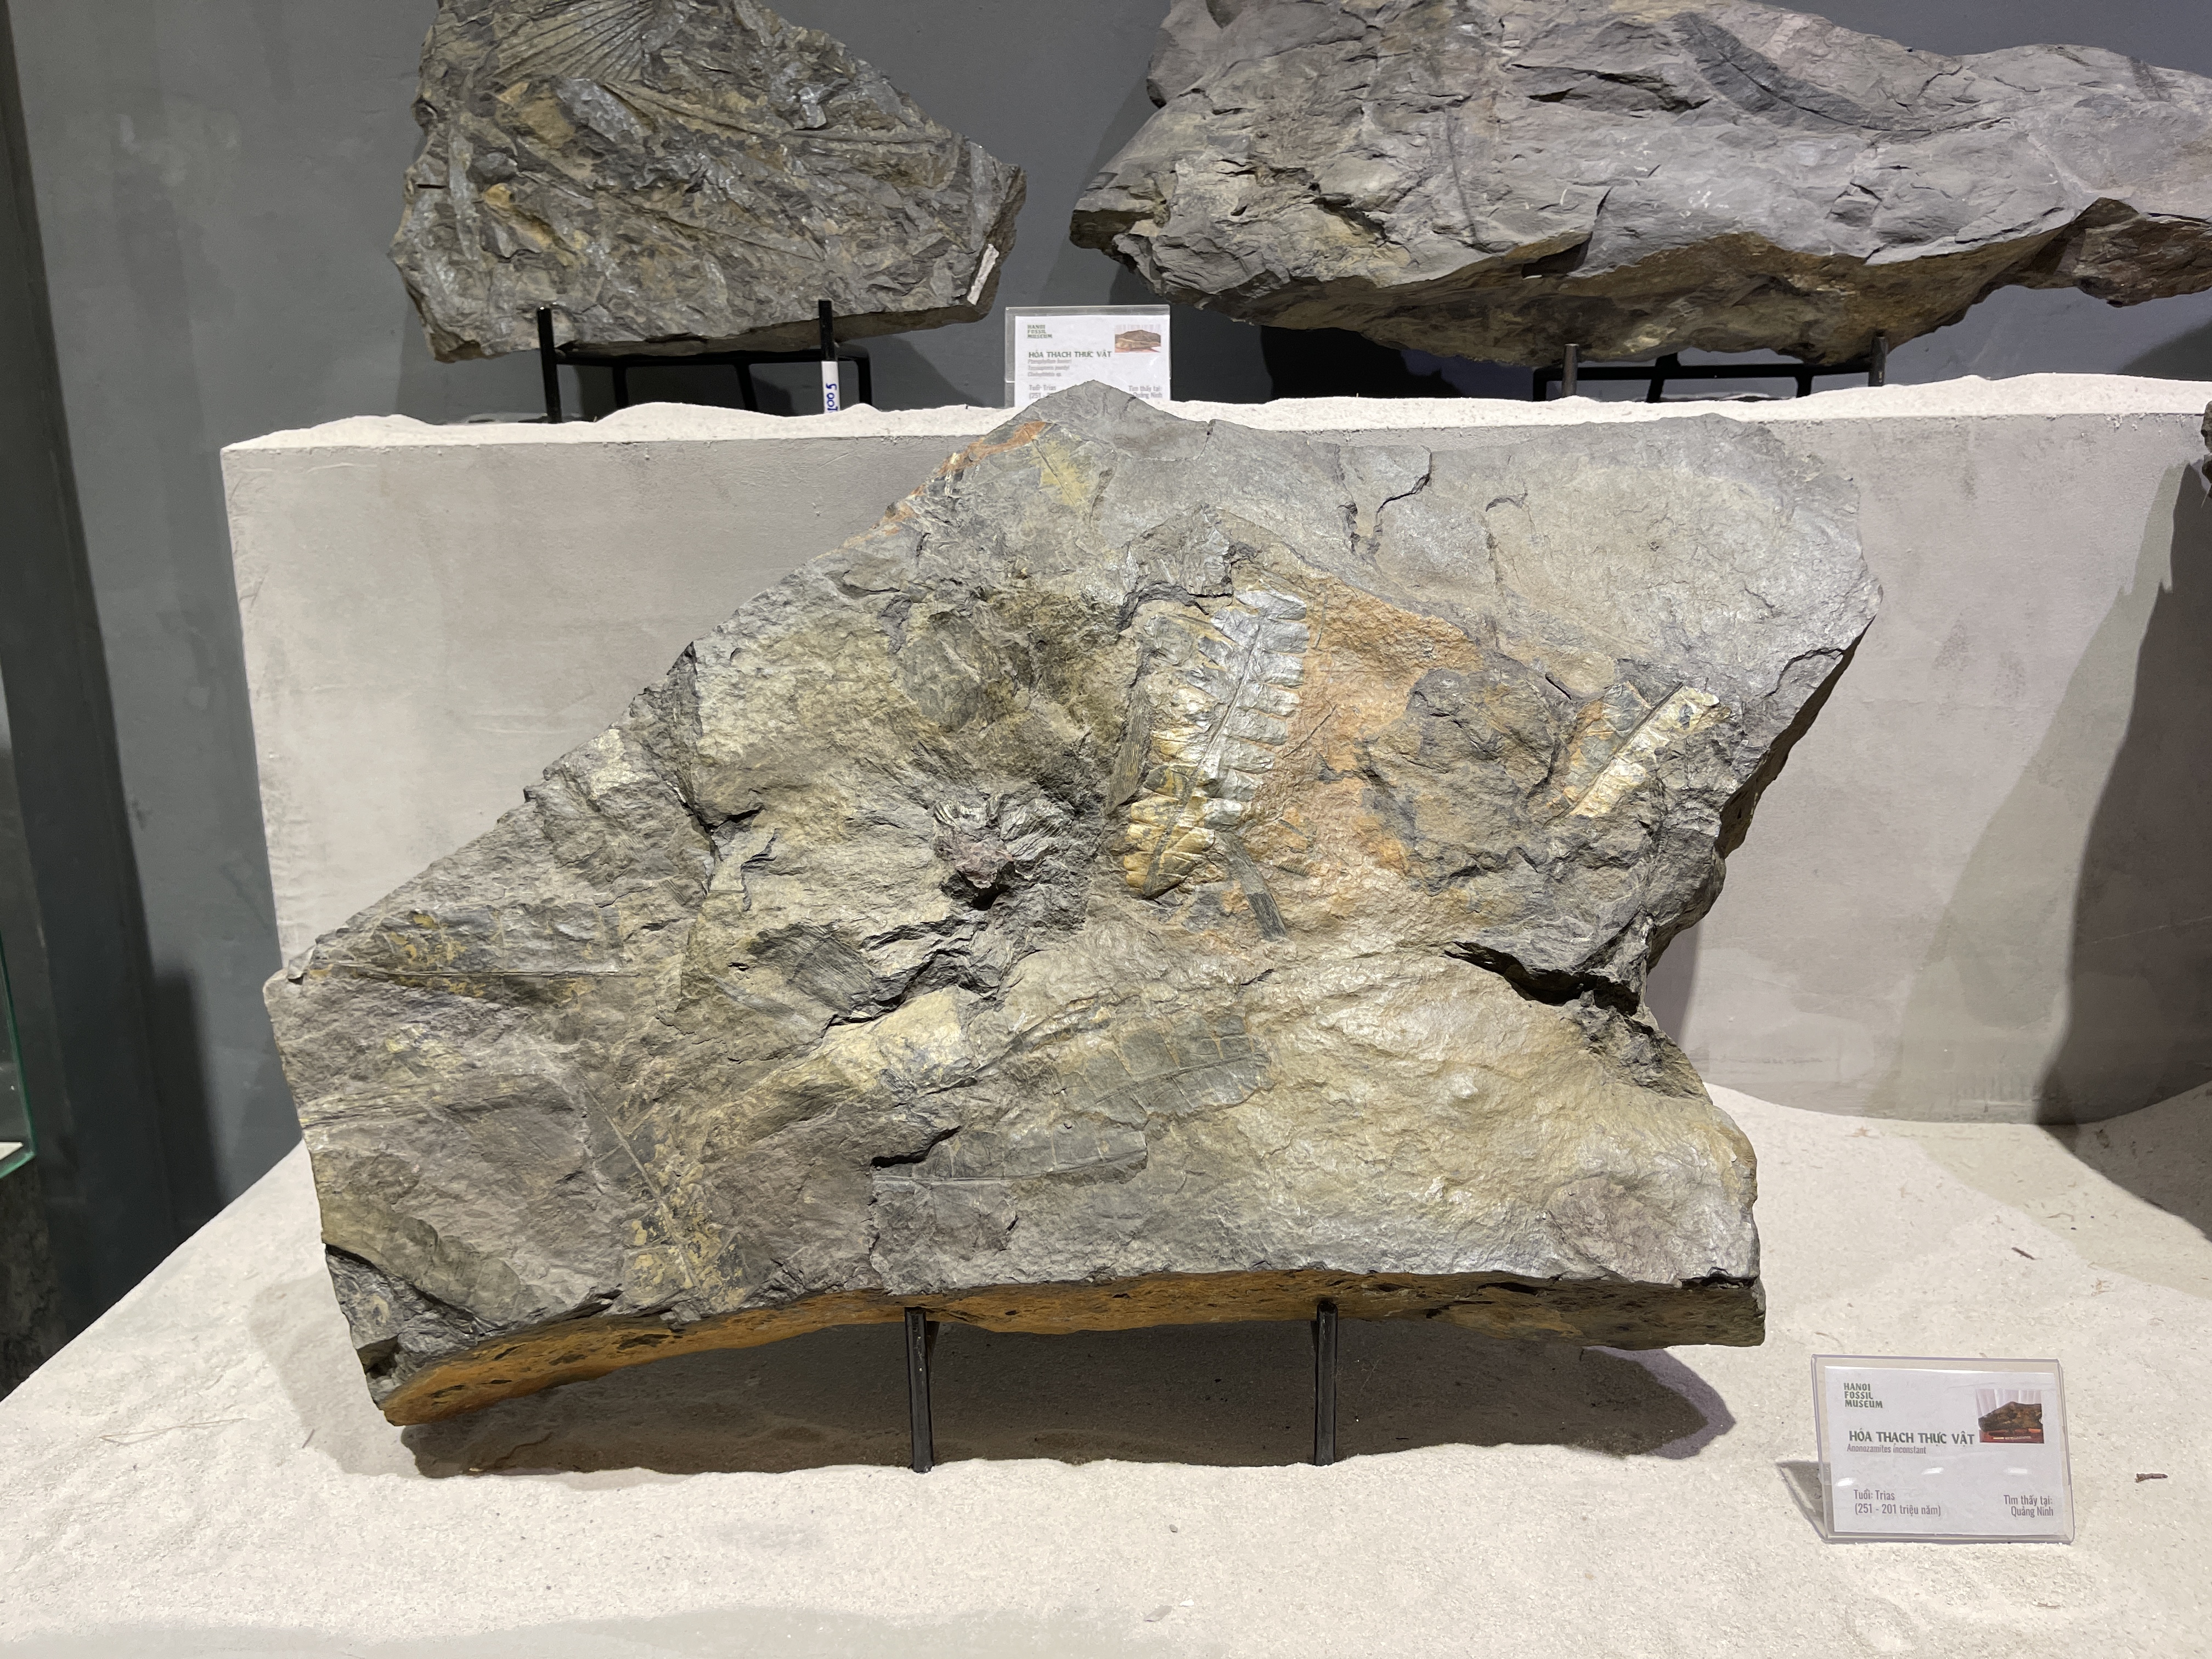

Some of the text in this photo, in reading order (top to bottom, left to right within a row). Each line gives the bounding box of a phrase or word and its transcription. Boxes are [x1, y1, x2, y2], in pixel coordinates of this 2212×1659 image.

[1843, 1383, 1870, 1391] HANOI
[1844, 1391, 1873, 1400] FOSSIL
[1845, 1400, 1883, 1408] MUSEUM
[1849, 1427, 1975, 1447] HÓA THẠCH THỰC VẬT
[1893, 1445, 1926, 1454] inconstant
[1853, 1489, 1895, 1500] Tuổi: Trias
[2021, 1494, 2037, 1506] thấy
[2040, 1496, 2053, 1506] tại:
[1855, 1503, 1872, 1515] (251
[1882, 1504, 1897, 1514] 201
[1900, 1505, 1918, 1516] triệu
[1921, 1505, 1942, 1517] năm)
[2011, 1506, 2054, 1518] Quảng Ninh
